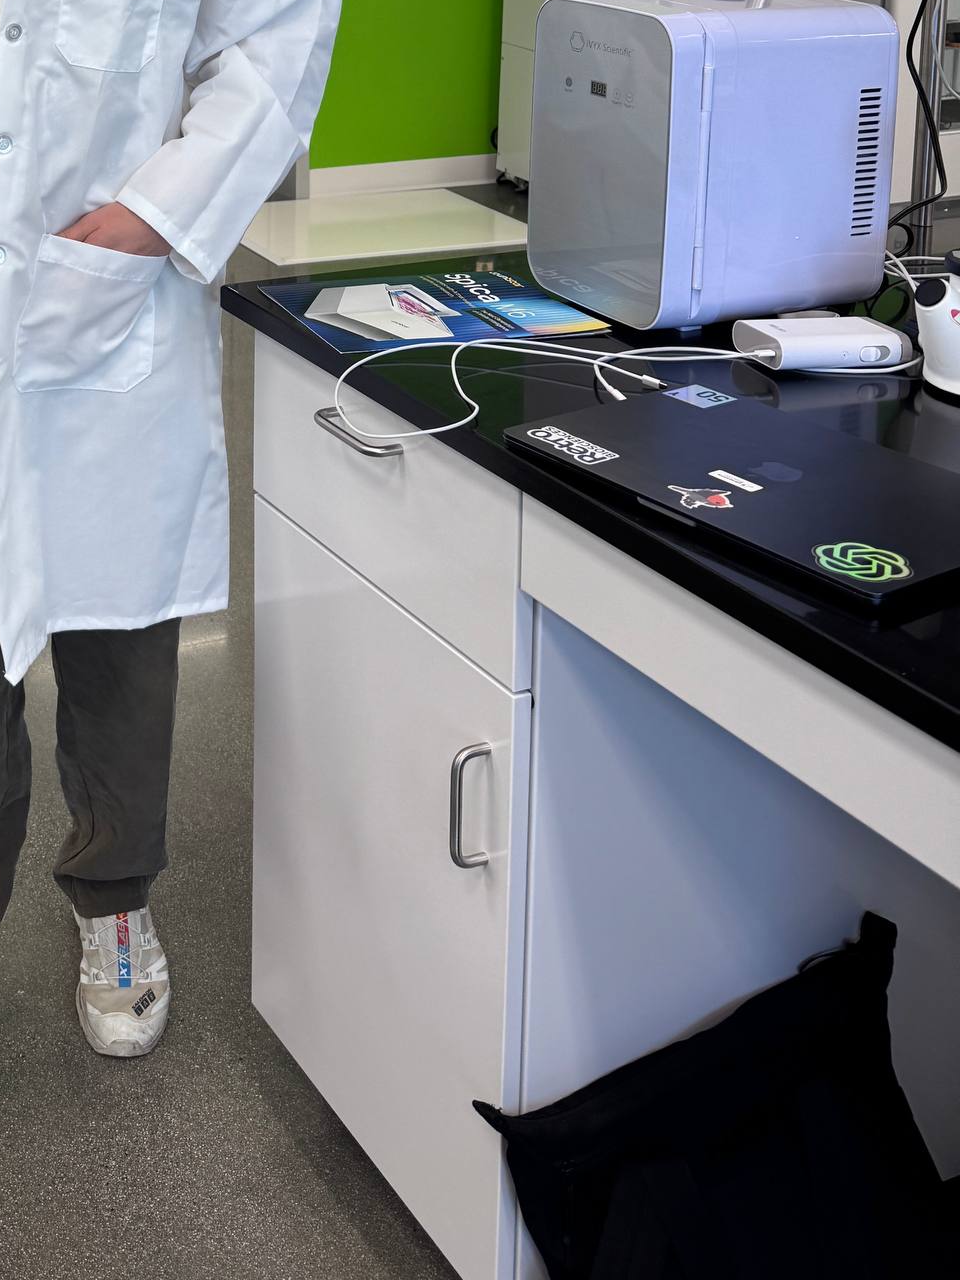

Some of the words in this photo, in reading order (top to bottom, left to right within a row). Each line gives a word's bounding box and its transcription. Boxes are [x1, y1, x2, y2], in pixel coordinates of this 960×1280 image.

[602, 42, 632, 57] Scientific
[530, 429, 608, 463] Retro
[544, 426, 617, 458] BIOSCIENCES
